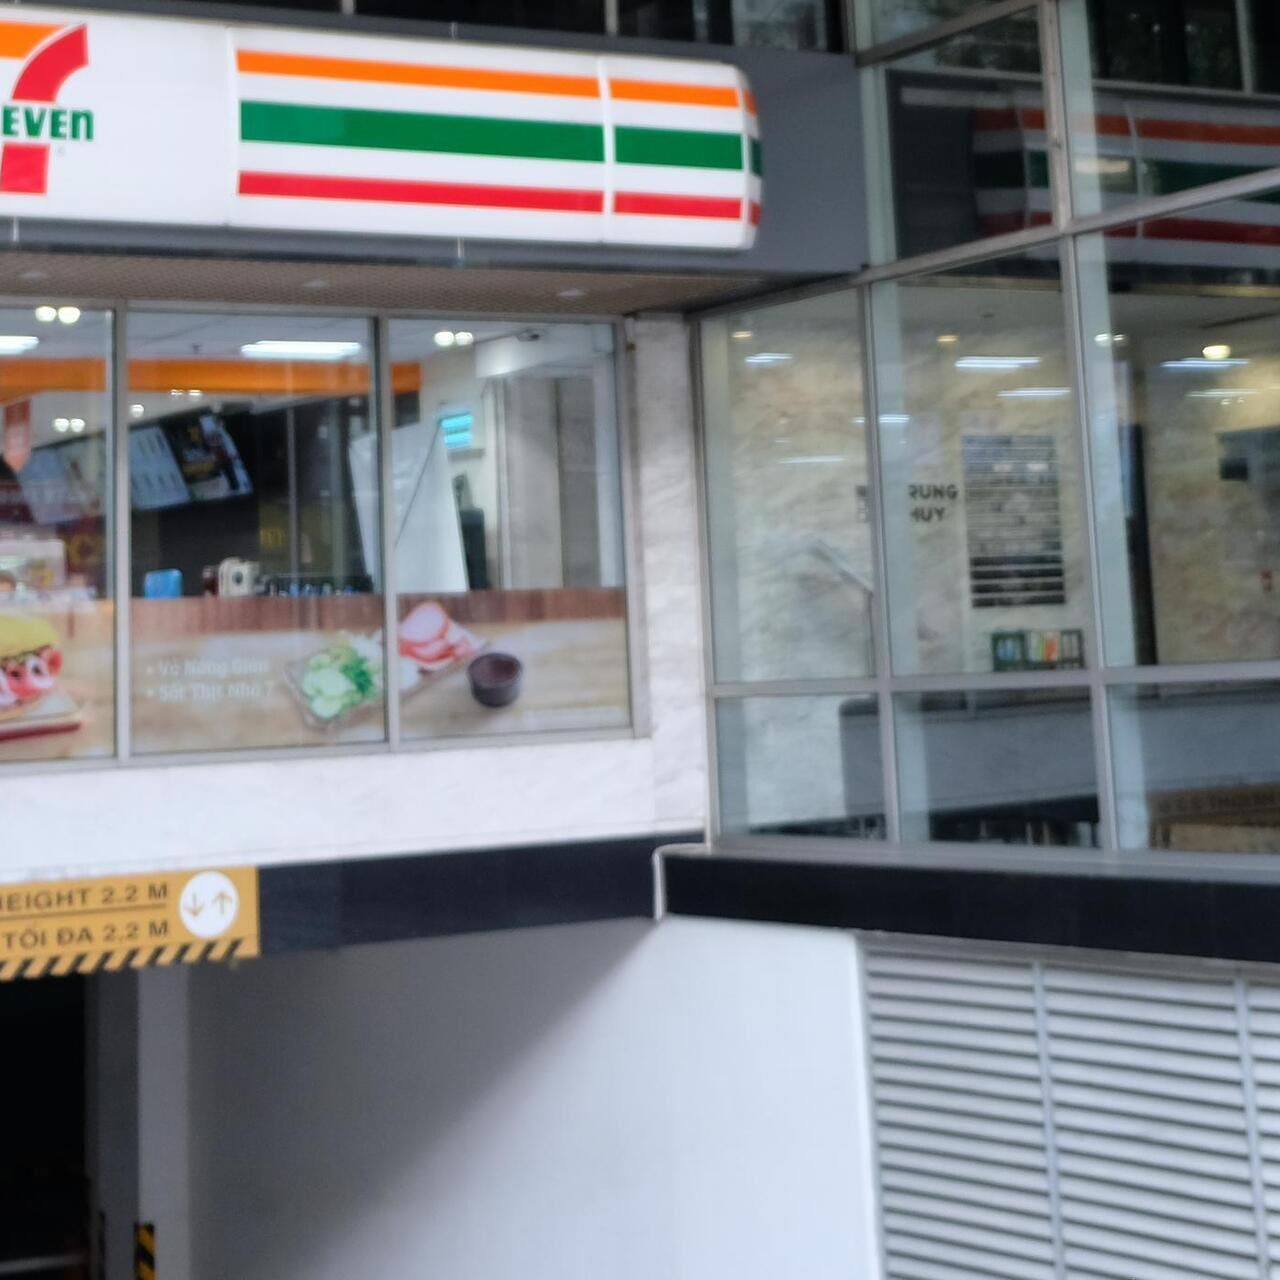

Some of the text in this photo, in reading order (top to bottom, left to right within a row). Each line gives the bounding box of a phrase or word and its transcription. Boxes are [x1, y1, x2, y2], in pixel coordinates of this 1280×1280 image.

[148, 882, 168, 900] M
[56, 925, 93, 946] ĐA
[149, 920, 168, 938] M
